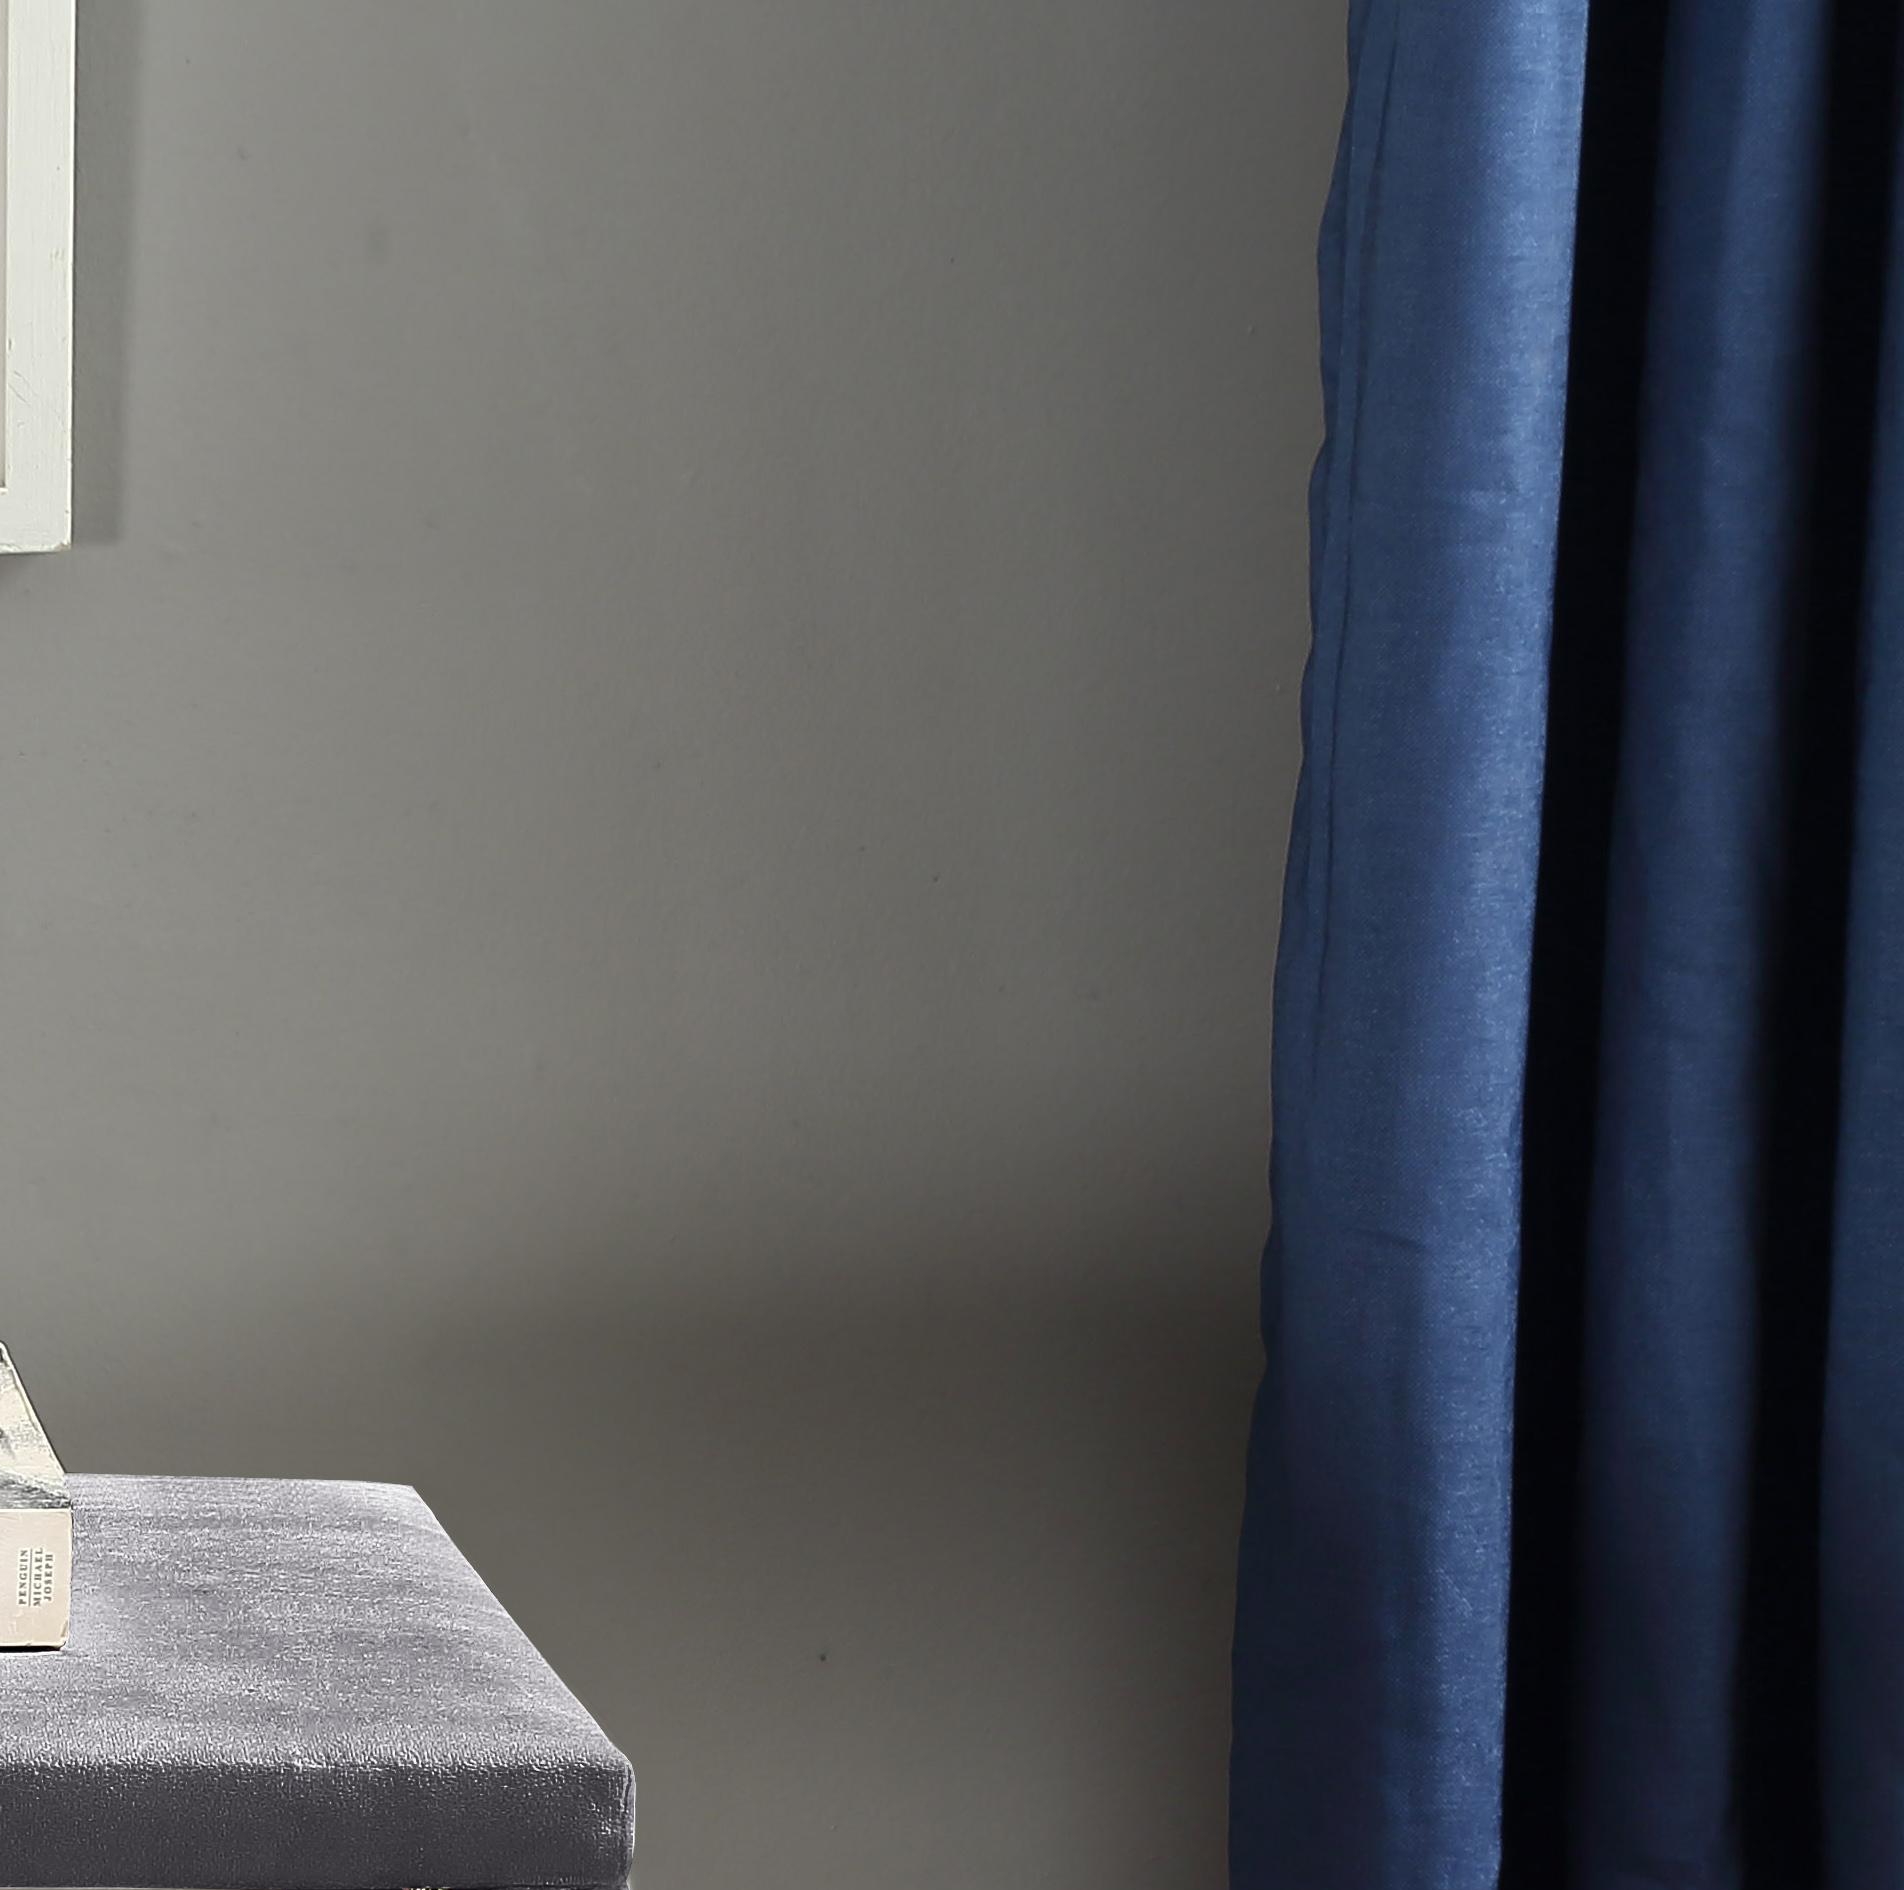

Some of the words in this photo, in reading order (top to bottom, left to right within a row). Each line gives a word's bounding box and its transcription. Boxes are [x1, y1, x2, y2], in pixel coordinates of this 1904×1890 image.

[17, 1549, 28, 1606] PENGUIN
[32, 1547, 44, 1607] MICHAEL
[43, 1553, 54, 1602] JOSEPH
